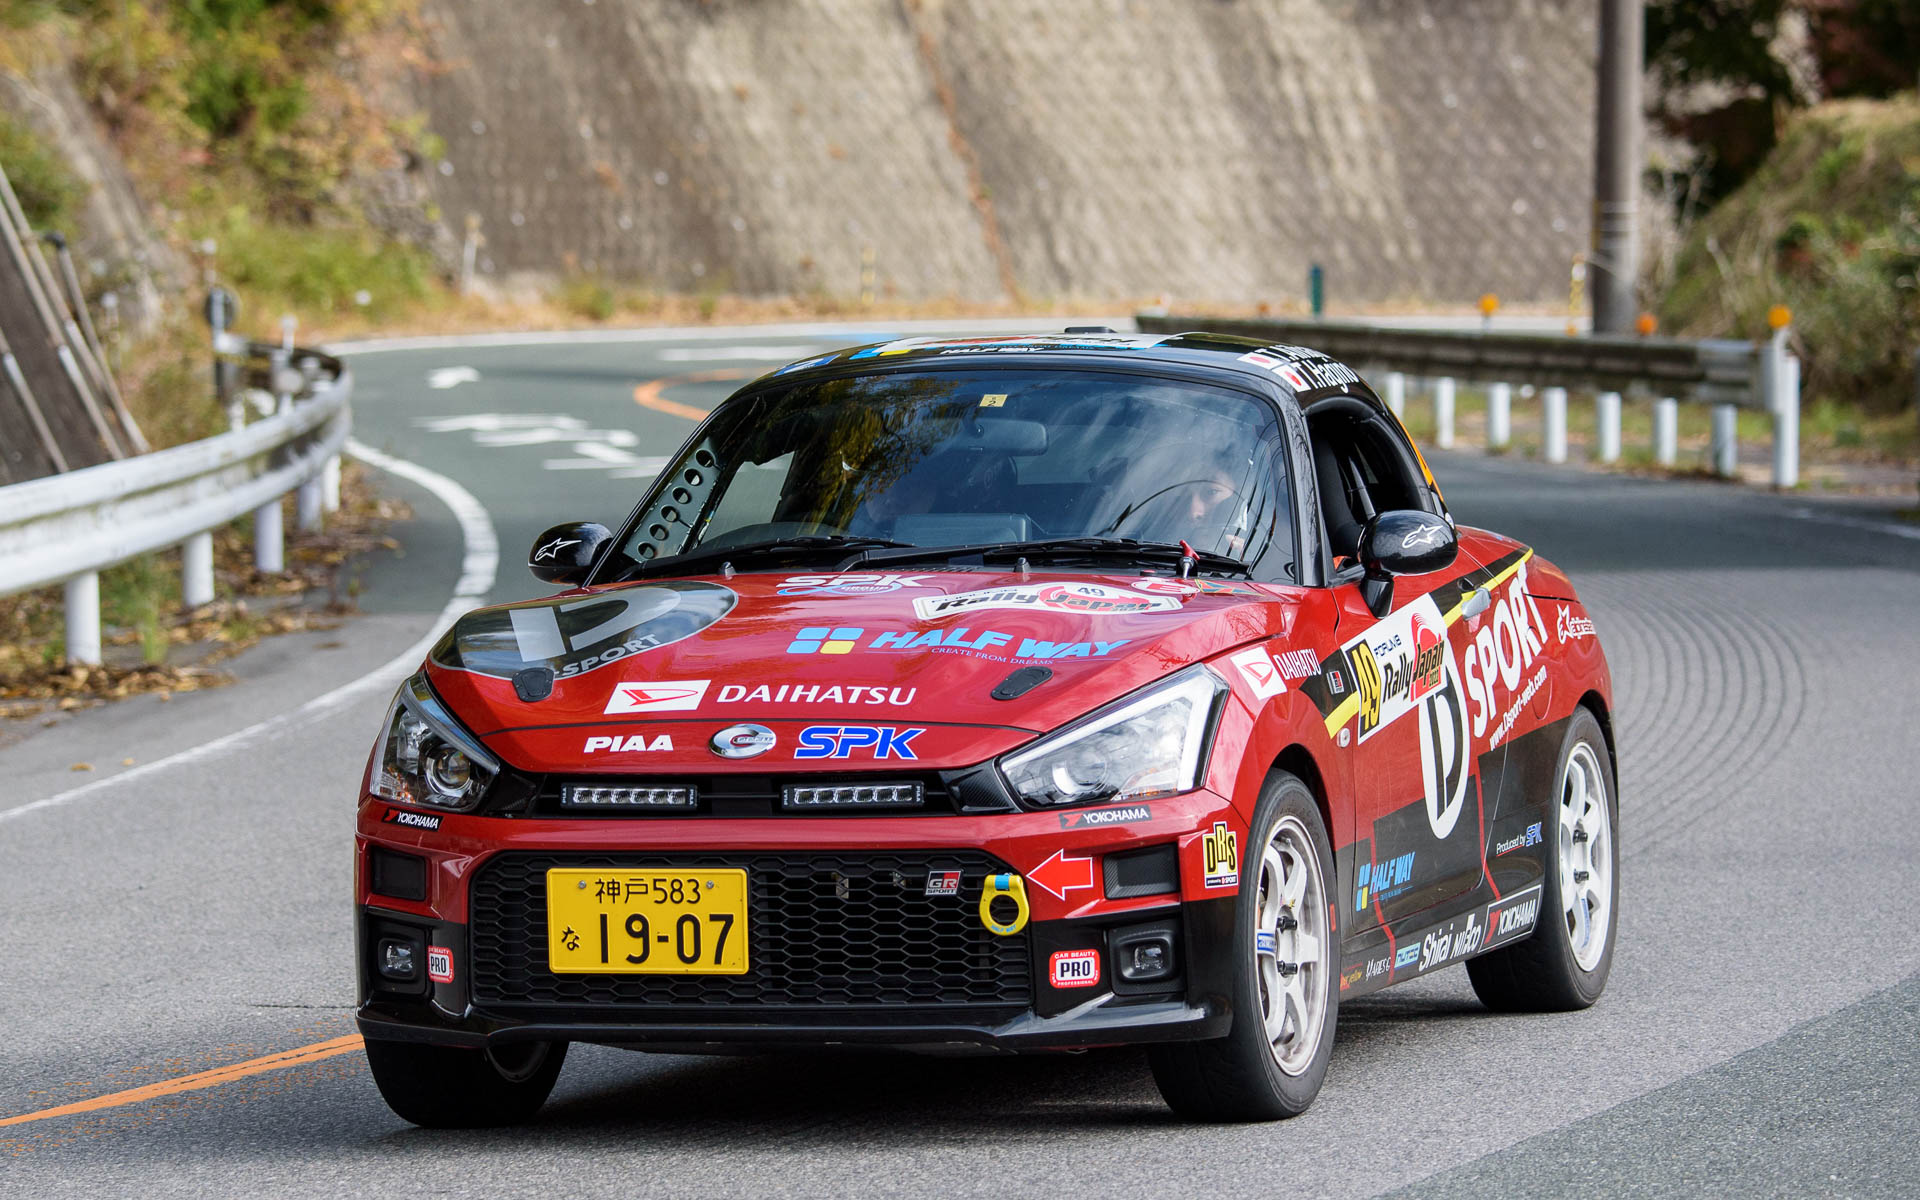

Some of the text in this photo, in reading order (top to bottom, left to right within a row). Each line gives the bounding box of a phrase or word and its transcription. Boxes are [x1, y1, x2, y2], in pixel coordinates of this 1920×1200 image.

[1289, 357, 1360, 393] T.Hagino
[776, 574, 937, 588] SPK
[1077, 586, 1105, 597] 49
[936, 592, 1039, 612] Rally
[1046, 593, 1162, 611] Japan
[868, 627, 1133, 659] HALF WAY
[931, 646, 1054, 666] CREATE FROM DREAMS
[1465, 560, 1548, 738] SPORT
[1272, 648, 1322, 680] DAIHATSU
[1382, 652, 1414, 704] Rally
[1412, 640, 1445, 688] Japan
[716, 684, 917, 706] DAIHATSU
[1351, 643, 1381, 731] 49
[1489, 665, 1549, 751] www.Dsport-web.com
[583, 734, 674, 754] PIAA
[793, 725, 927, 760] SPK
[398, 812, 439, 829] YOKOHAMA
[1083, 808, 1149, 824] YOKOHAMA
[1205, 823, 1236, 873] DRS
[1496, 821, 1543, 855] Produced by SPK
[929, 878, 958, 889] GR
[1369, 851, 1416, 895] HALF WAY
[595, 877, 702, 904] 神戸583
[1498, 899, 1536, 937] YOKOHAMA
[561, 913, 735, 965] な 19-07
[1419, 923, 1454, 972] Shirai
[430, 955, 447, 973] PRO
[1060, 960, 1091, 978] PRO
